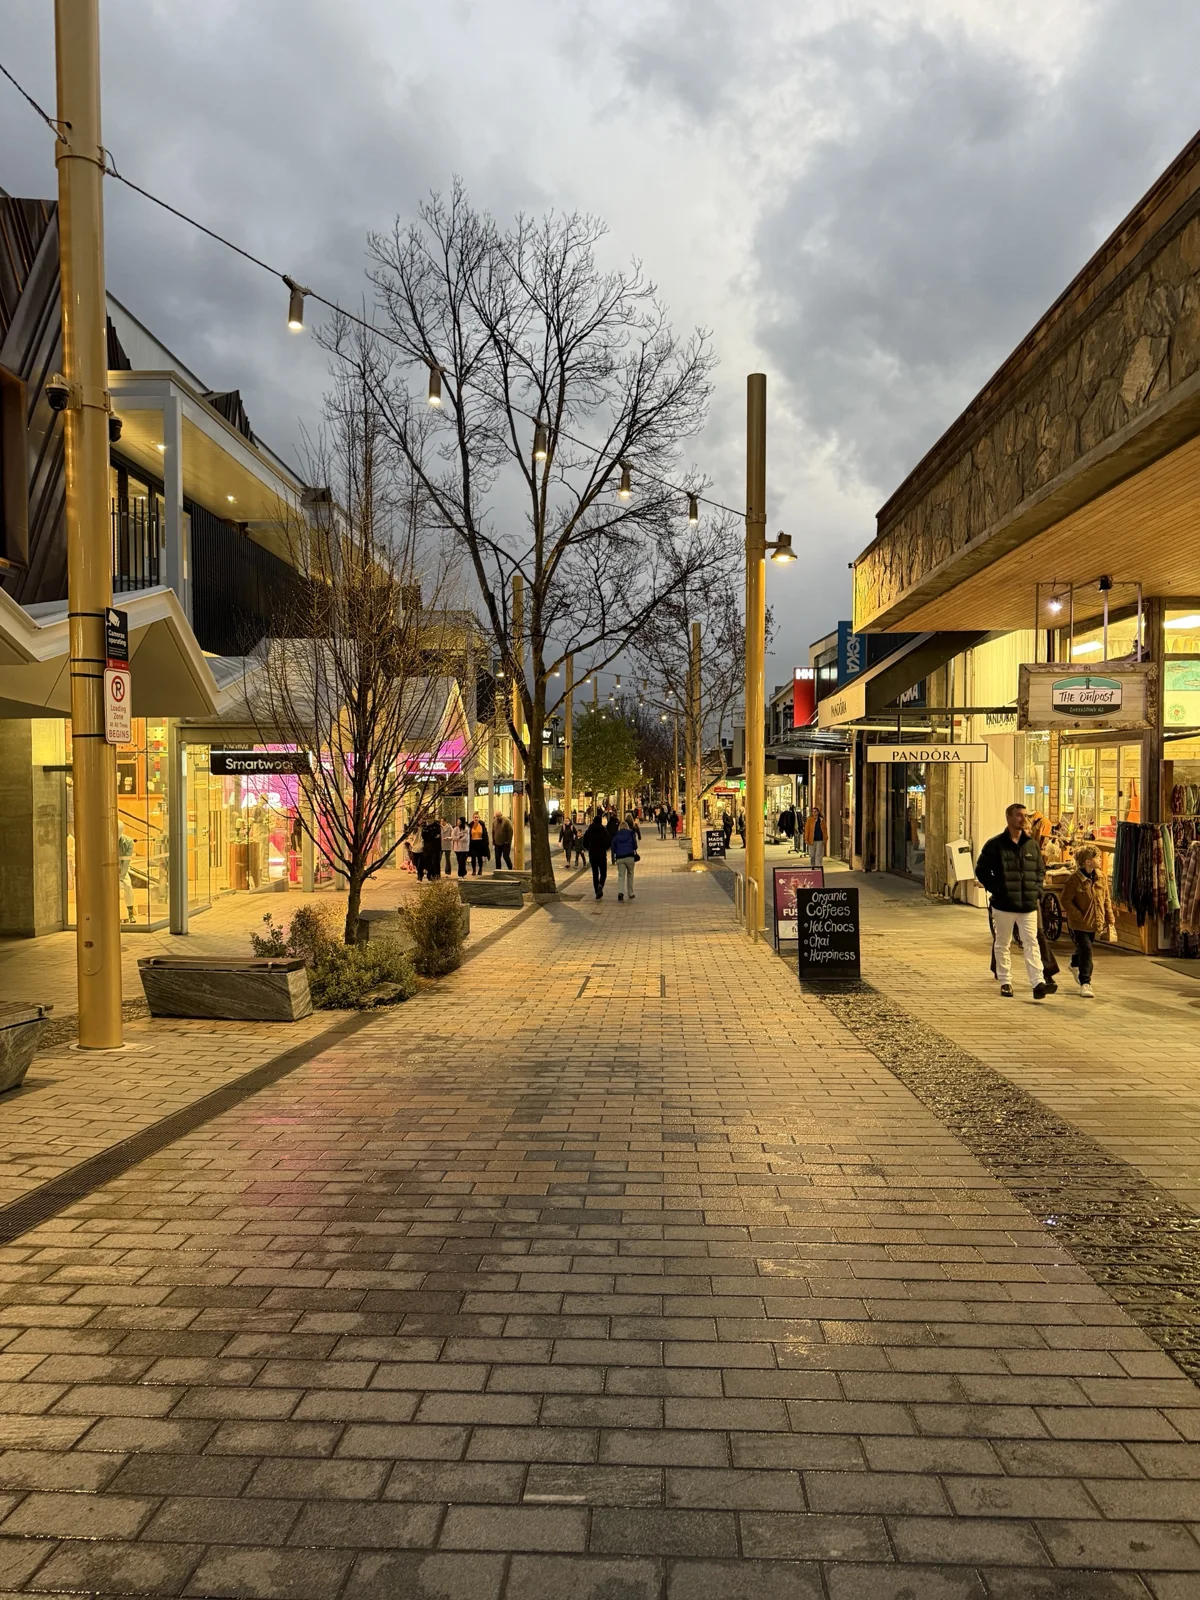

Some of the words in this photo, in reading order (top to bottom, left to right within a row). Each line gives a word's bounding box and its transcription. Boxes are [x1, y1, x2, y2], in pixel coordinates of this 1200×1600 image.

[108, 630, 125, 638] Cameras
[108, 638, 126, 647] operating
[1058, 690, 1076, 703] THE
[1079, 690, 1114, 704] Outpost
[110, 704, 126, 714] Loading
[113, 712, 124, 720] Zone
[109, 729, 130, 739] BEGINS
[812, 890, 848, 906] Organic
[806, 902, 850, 919] Coffees
[808, 920, 824, 934] Hot
[824, 918, 855, 933] Chocs
[809, 934, 830, 949] Chai
[809, 948, 856, 963] Happiness
